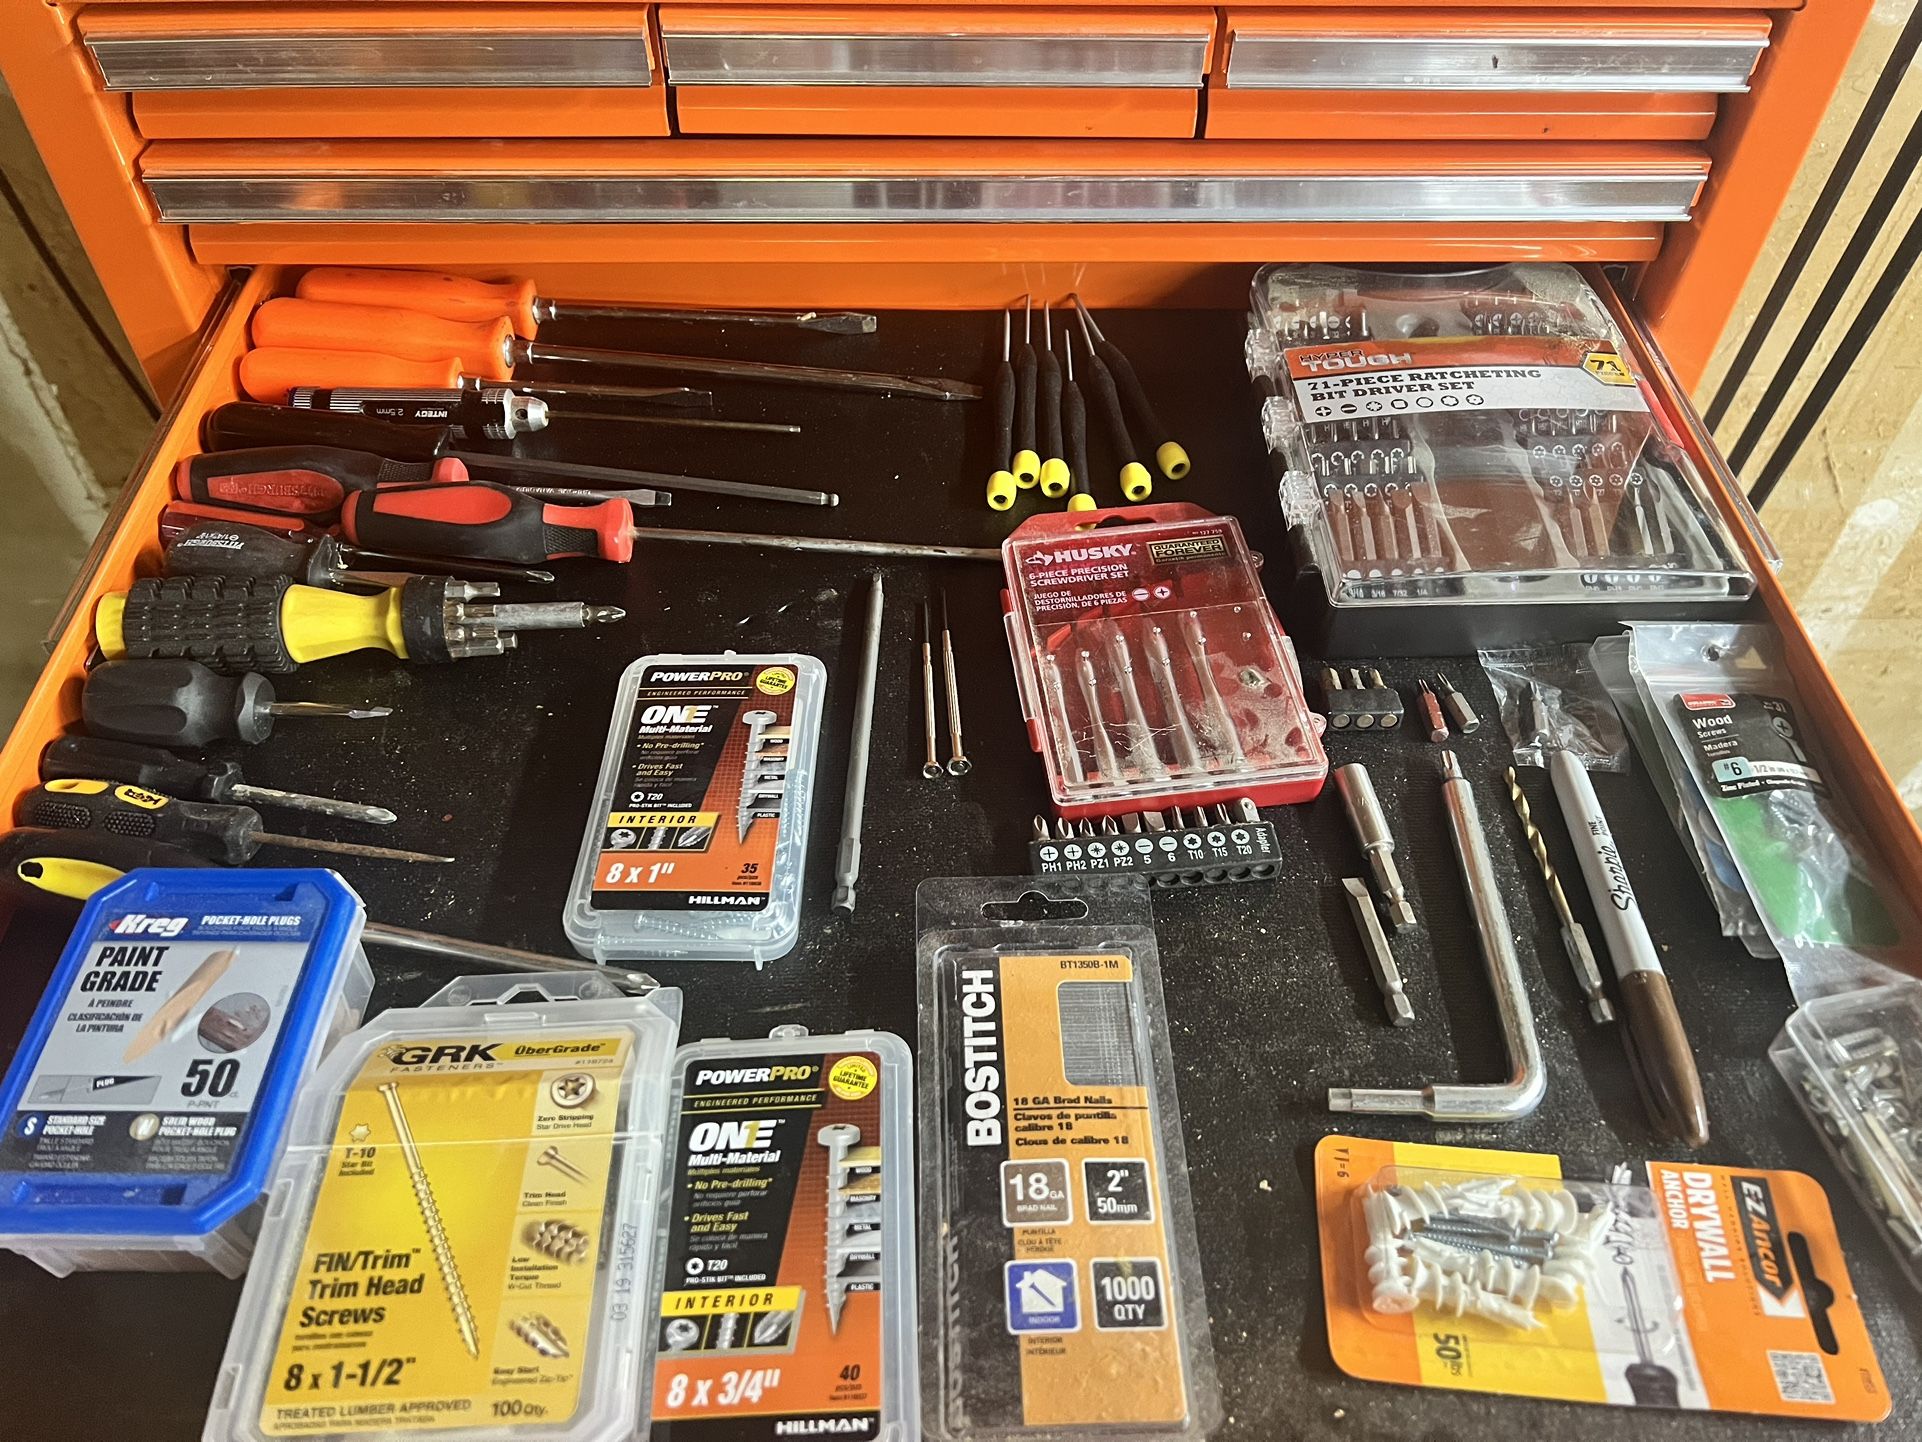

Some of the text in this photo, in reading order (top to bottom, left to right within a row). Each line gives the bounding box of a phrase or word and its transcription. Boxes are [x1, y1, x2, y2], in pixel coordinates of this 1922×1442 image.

[1299, 349, 1364, 362] HYPER
[1301, 352, 1413, 372] TOUGH
[1307, 368, 1543, 391] 71-PIECE RATCHETING
[1311, 381, 1475, 402] BIT DRIVER SET
[185, 539, 245, 550] PITTSBURGH
[1154, 539, 1219, 551] GUARANTEED
[1155, 544, 1222, 557] FOREVER
[1053, 544, 1133, 563] HUSKY
[1029, 563, 1128, 580] 6-PIECE PRECISION
[1030, 570, 1129, 587] SCREWDRIVER SET
[1033, 591, 1059, 600] JUEGO
[1035, 591, 1115, 606] DESTORNILLADORES
[1036, 602, 1080, 612] PRECISIÓN,
[1100, 597, 1128, 606] PIEZAS
[639, 724, 713, 733] Multi-Material
[1692, 714, 1733, 729] Wood
[1697, 728, 1727, 739] Screws
[1703, 740, 1738, 752] Madera
[1723, 761, 1769, 776] #6 1/2
[1720, 783, 1737, 792] Zinc
[1738, 780, 1760, 790] Plated
[646, 792, 664, 801] T20
[618, 815, 699, 824] INTERIOR
[1588, 821, 1599, 836] FINE
[1041, 827, 1271, 873] PH1 PH2 PZ1 PZ2 5 6 T10 T15 T20 Adapter
[606, 862, 676, 885] 8 x 1"
[741, 863, 759, 874] 35
[1597, 843, 1638, 911] Sharpie
[688, 895, 761, 905] HILLMAN
[114, 914, 189, 937] Kreg
[201, 915, 302, 926] POCKET-HOLE PLUGS
[95, 946, 170, 968] PAINT
[1060, 960, 1119, 969] BT1350B-1M
[81, 970, 163, 993] GRADE
[95, 999, 134, 1008] PEINDRE
[131, 1013, 144, 1022] DE
[75, 1024, 125, 1033] LA PINTURA
[394, 1043, 504, 1066] GRK
[962, 969, 1002, 1146] BOSTITCH
[95, 1077, 115, 1088] PLUG
[181, 1058, 241, 1098] 50
[833, 1075, 869, 1090] GUARANTEE
[840, 1070, 867, 1082] LIFETIME
[694, 1094, 818, 1108] ENGINEERED PERFORMANCE
[1013, 1096, 1113, 1106] 18 GA Brad Nails
[47, 1115, 89, 1125] STANDARD
[162, 1116, 189, 1127] SOLID
[188, 1116, 216, 1127] WOOD
[558, 1114, 594, 1122] Stripping
[1013, 1111, 1117, 1121] Clavos de puntilla
[24, 1117, 38, 1136] S
[42, 1125, 95, 1136] POCKET-HOLE
[158, 1126, 215, 1137] POCKET-HOLE
[214, 1126, 238, 1137] PLUG
[1014, 1122, 1073, 1132] calibre 18
[1015, 1135, 1129, 1147] Clous de calibre 18
[345, 1146, 376, 1159] T-10
[688, 1150, 781, 1167] Multi-Material
[695, 1181, 709, 1190] No
[1106, 1169, 1129, 1192] 2"
[545, 1191, 566, 1199] Head
[1660, 1169, 1690, 1230] ANCHOR
[1016, 1204, 1039, 1212] BRAD
[1097, 1198, 1138, 1214] 50mm
[691, 1211, 749, 1223] Drives Fast
[690, 1223, 738, 1233] and Easy
[1682, 1171, 1736, 1283] DRYWALL
[707, 1259, 728, 1272] T20
[309, 1273, 425, 1300] Trim Head
[686, 1273, 767, 1285] PRO-STIK INCLUDED
[615, 1278, 631, 1296] 19
[850, 1283, 875, 1291] PLASTIC
[1101, 1276, 1156, 1301] 1000
[675, 1292, 775, 1311] INTERIOR
[300, 1306, 385, 1328] Screws
[610, 1303, 628, 1322] 03
[1114, 1304, 1146, 1321] QTY
[1432, 1332, 1462, 1361] 50
[284, 1357, 417, 1391] 8 x 1-1/2"
[839, 1364, 861, 1381] 40
[667, 1368, 781, 1408] 8 x 3/4"
[277, 1398, 471, 1420] TREATED LUMBER APPROVED
[492, 1400, 523, 1417] 100
[775, 1418, 870, 1436] HILLMAN
